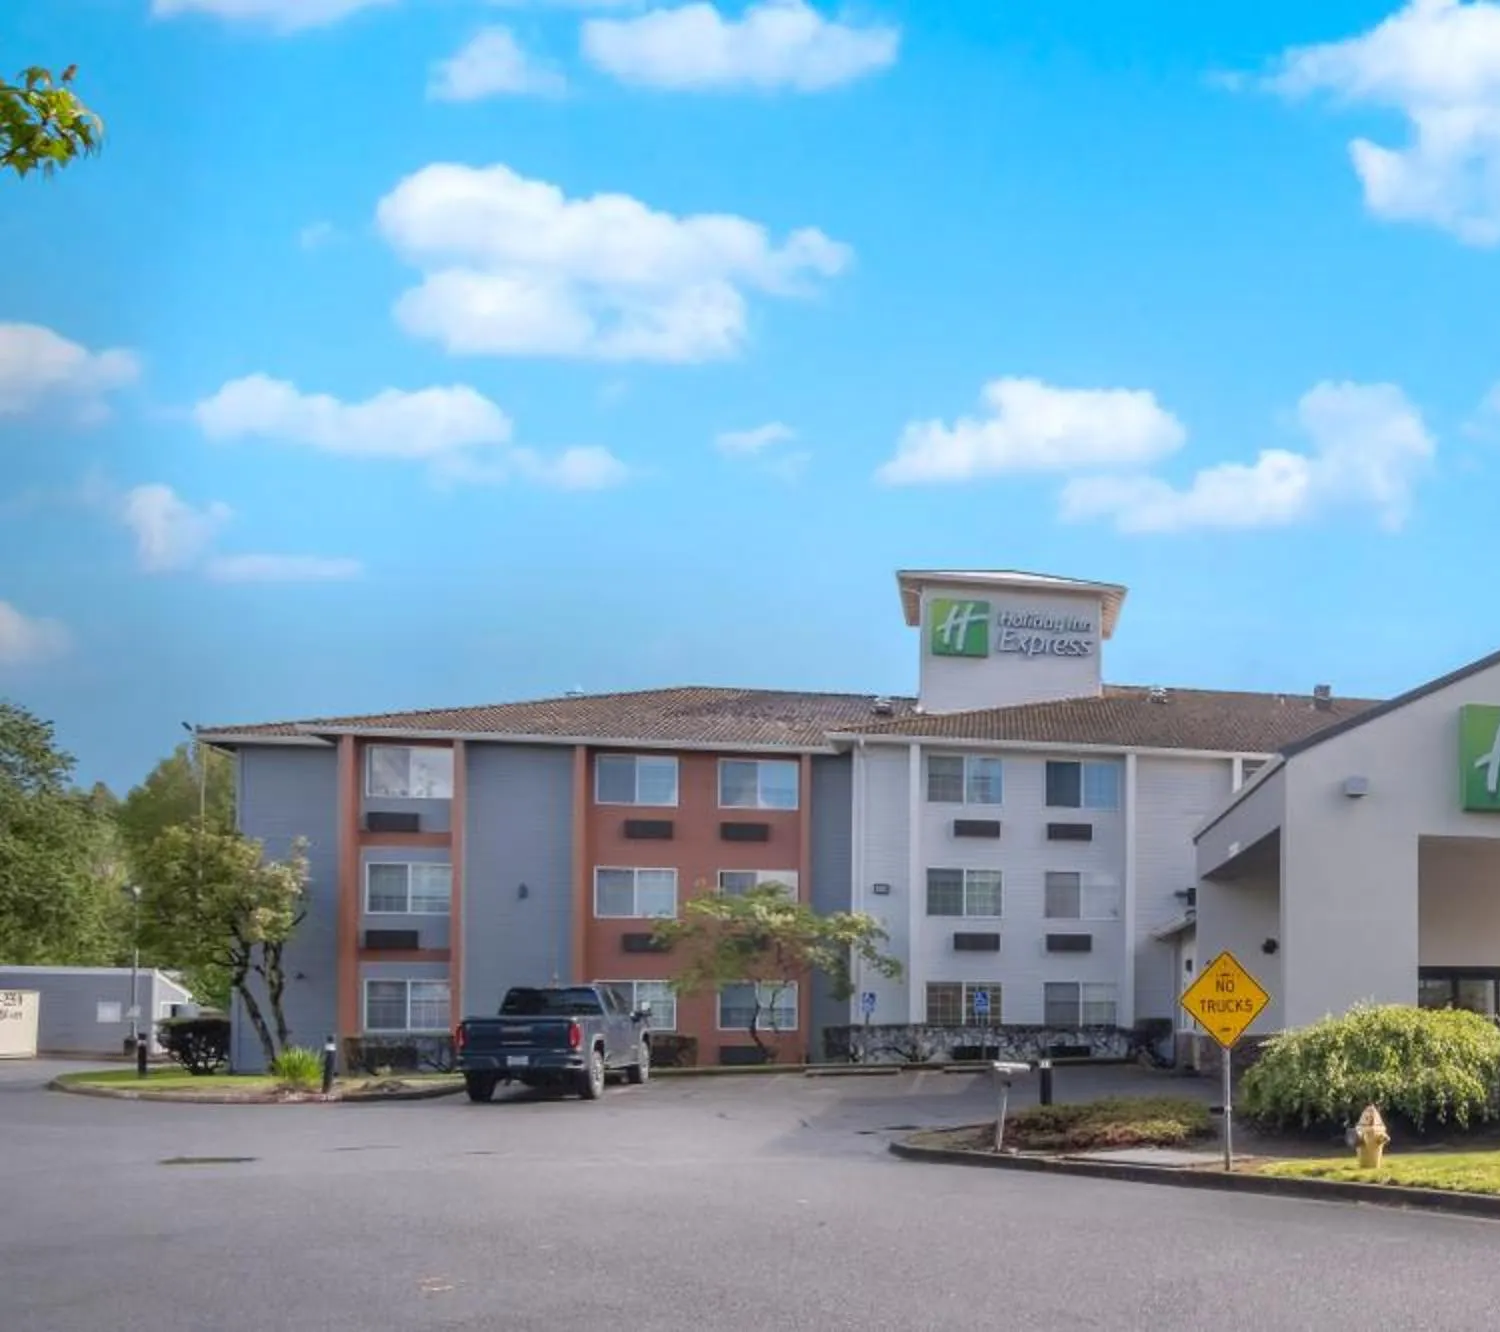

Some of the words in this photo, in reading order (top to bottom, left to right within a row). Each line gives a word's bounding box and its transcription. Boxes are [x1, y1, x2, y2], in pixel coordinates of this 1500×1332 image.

[999, 611, 1062, 633] Holiday
[1067, 615, 1092, 632] Inn
[1000, 629, 1093, 657] Express
[1215, 979, 1235, 992] NO
[1200, 999, 1253, 1013] TRUCKS
